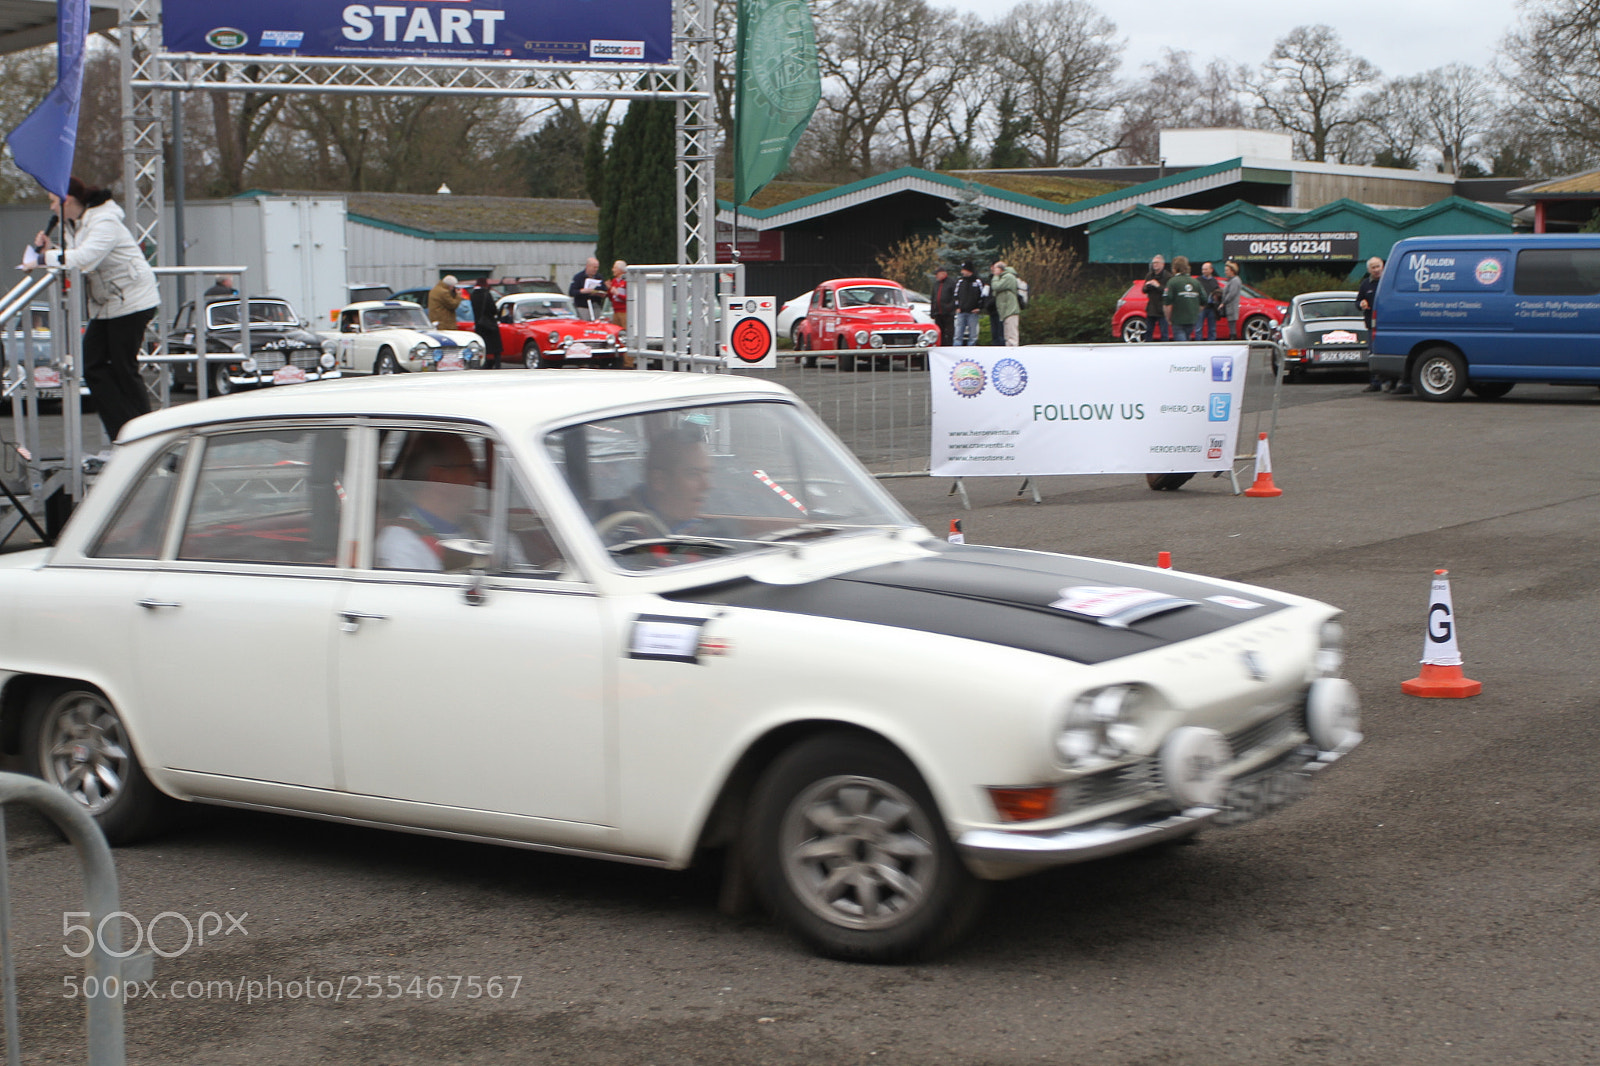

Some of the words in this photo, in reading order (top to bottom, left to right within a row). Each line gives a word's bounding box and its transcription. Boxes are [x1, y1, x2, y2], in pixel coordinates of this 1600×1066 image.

[341, 4, 506, 45] START
[1250, 241, 1287, 254] 01455
[1289, 241, 1331, 253] 612341
[1521, 301, 1544, 309] Classic
[1033, 404, 1114, 421] FOLLOW
[1121, 403, 1145, 420] US
[1210, 438, 1223, 448] You
[1428, 602, 1452, 644] G
